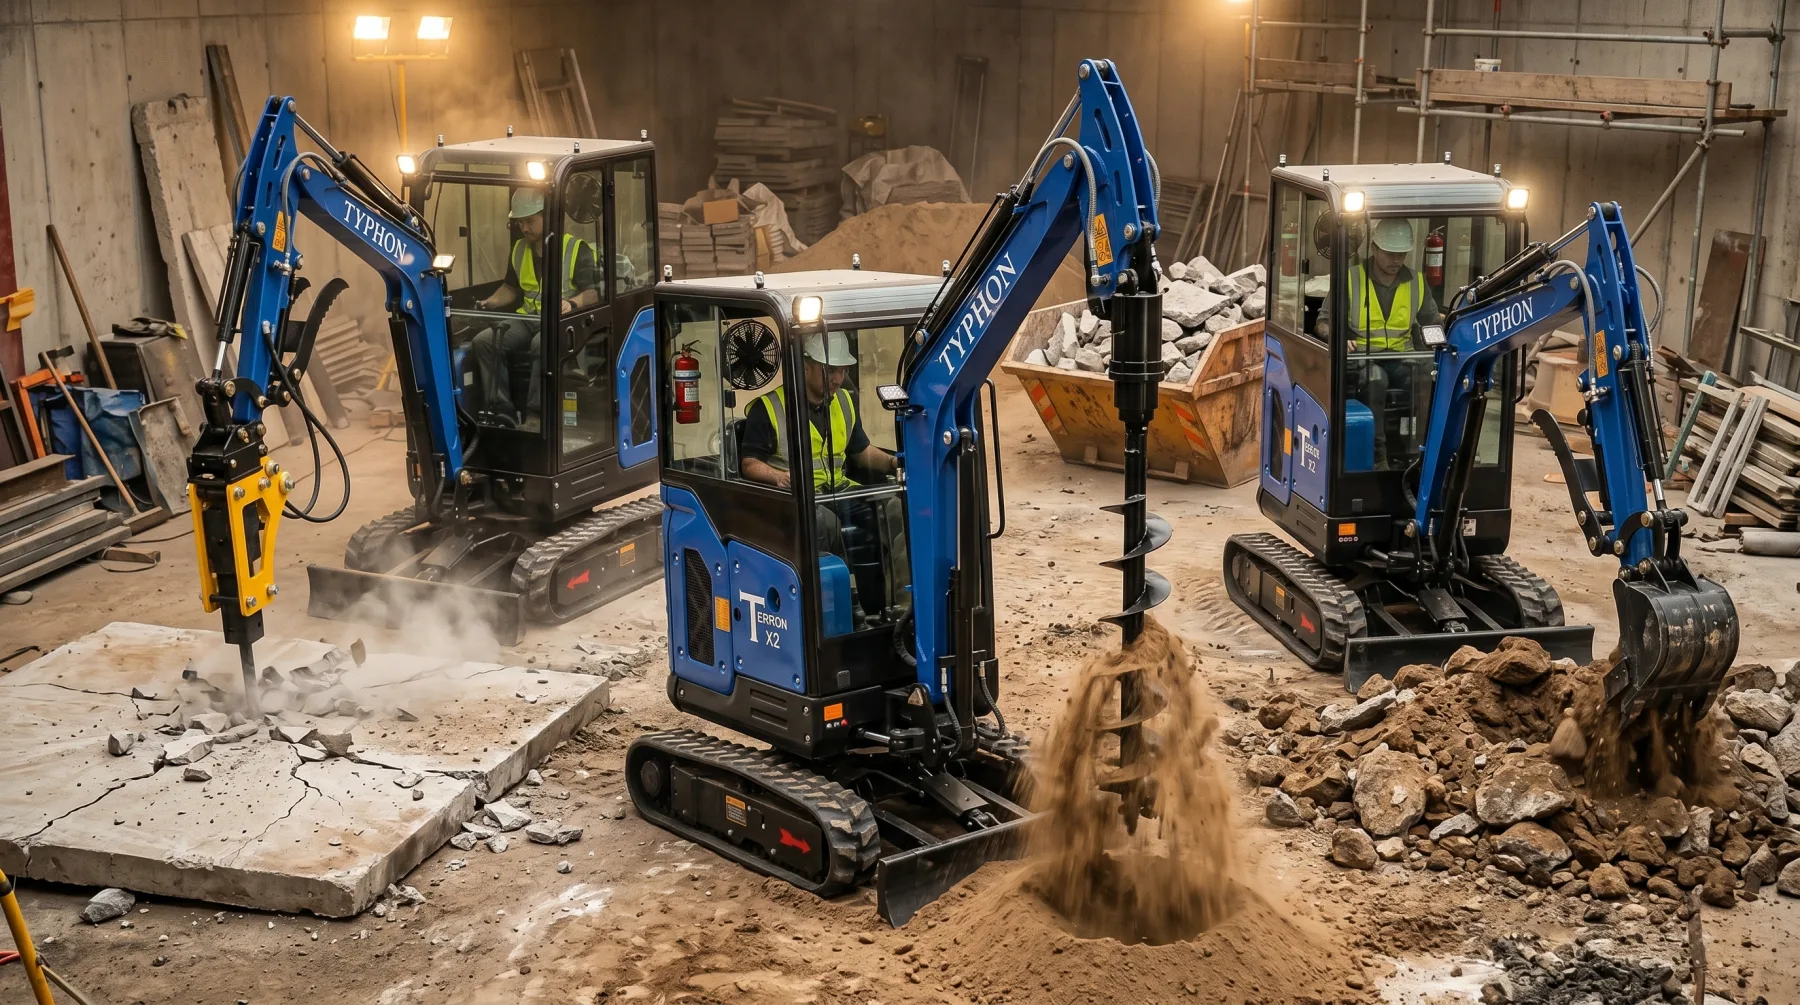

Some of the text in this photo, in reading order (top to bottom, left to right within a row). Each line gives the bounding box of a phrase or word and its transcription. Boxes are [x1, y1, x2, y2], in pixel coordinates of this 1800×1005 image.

[344, 200, 407, 262] TYPHON
[938, 251, 1016, 376] TYPHON
[1472, 296, 1533, 344] TYPHON
[739, 588, 788, 643] TERRON
[765, 629, 780, 649] X2
